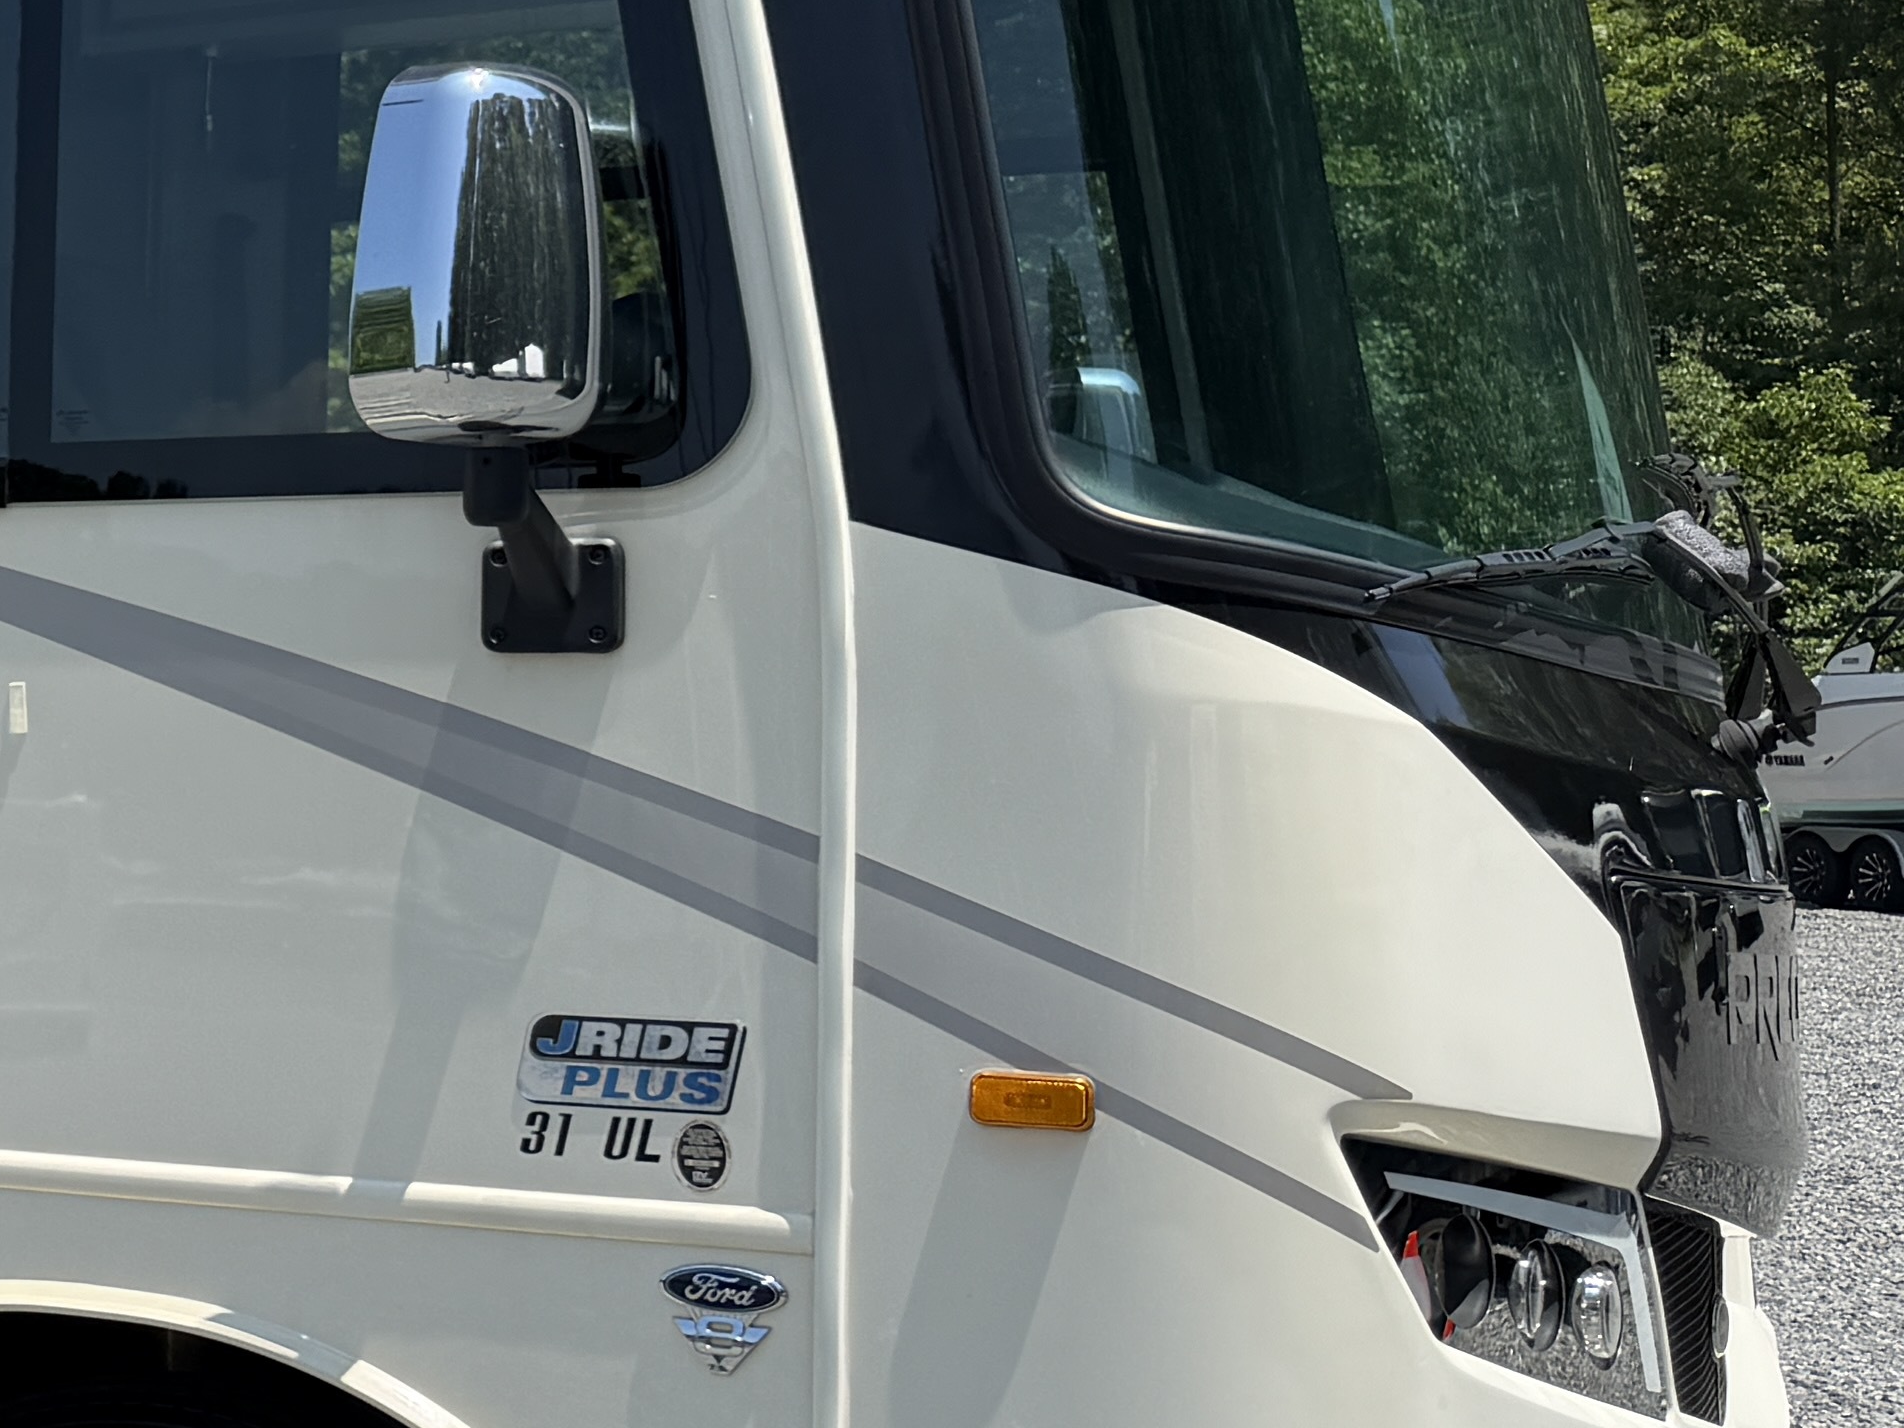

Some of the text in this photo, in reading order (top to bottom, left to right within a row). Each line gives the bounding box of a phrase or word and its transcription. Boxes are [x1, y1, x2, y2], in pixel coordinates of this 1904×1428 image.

[536, 1020, 730, 1063] JRIDE
[560, 1065, 723, 1105] PLUS
[520, 1111, 572, 1157] 31
[603, 1116, 661, 1163] UL
[684, 1273, 758, 1307] Ford
